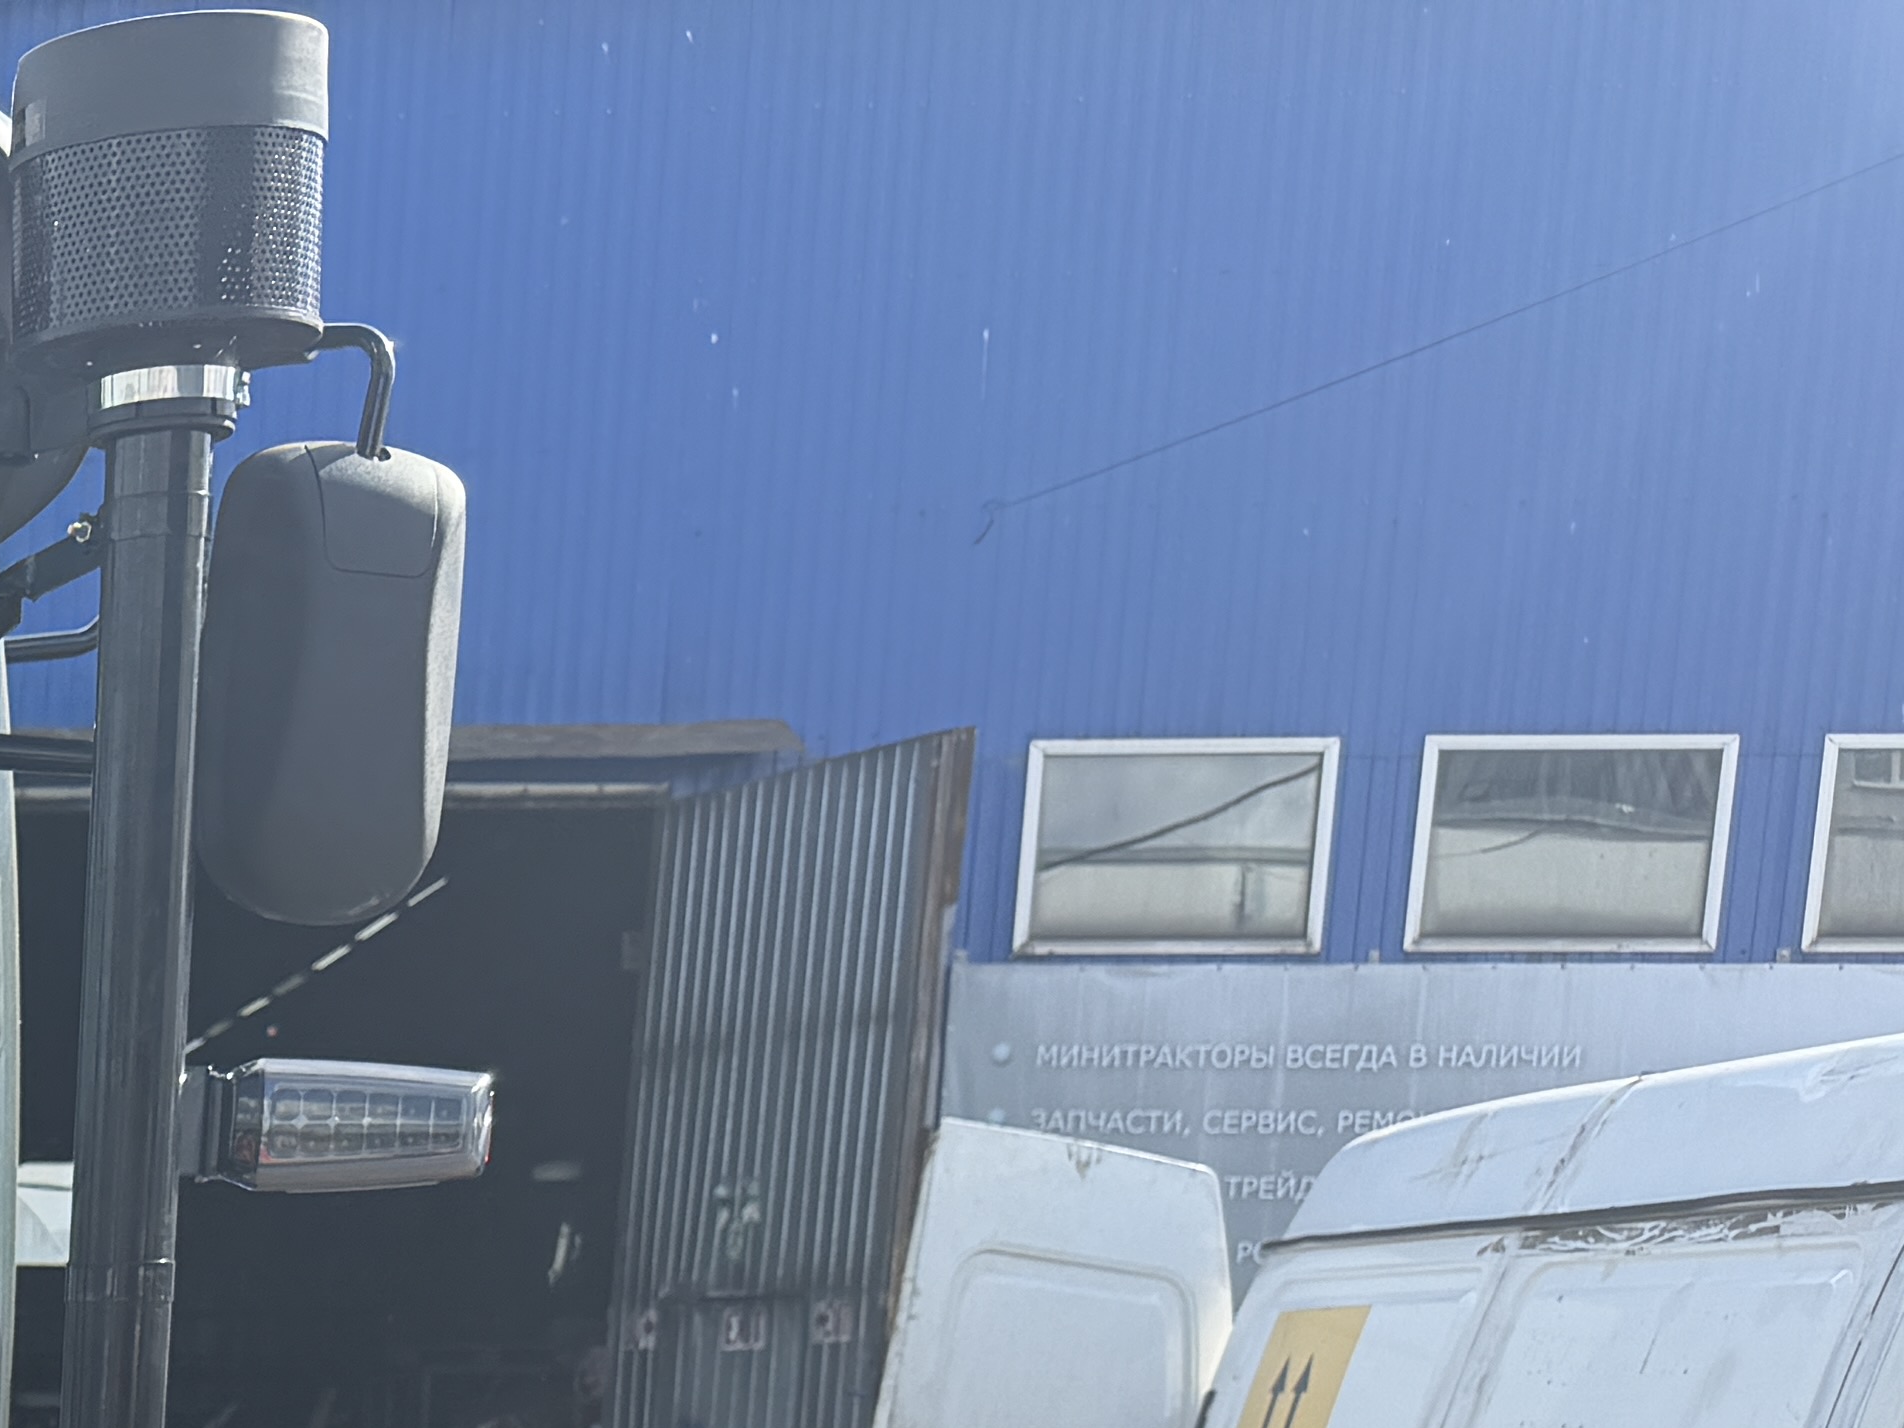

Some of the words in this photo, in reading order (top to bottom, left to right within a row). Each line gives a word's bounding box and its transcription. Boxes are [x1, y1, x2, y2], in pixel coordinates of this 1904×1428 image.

[1035, 1045, 1275, 1070] МИНИТРАКТОРЫ
[1285, 1044, 1398, 1072] ВСЕГДА
[1408, 1044, 1427, 1069] В
[1438, 1045, 1581, 1068] НАЛИЧИИ
[1030, 1107, 1190, 1138] ЗАПЧАСТИ,
[1201, 1109, 1325, 1138] СЕРВИС,
